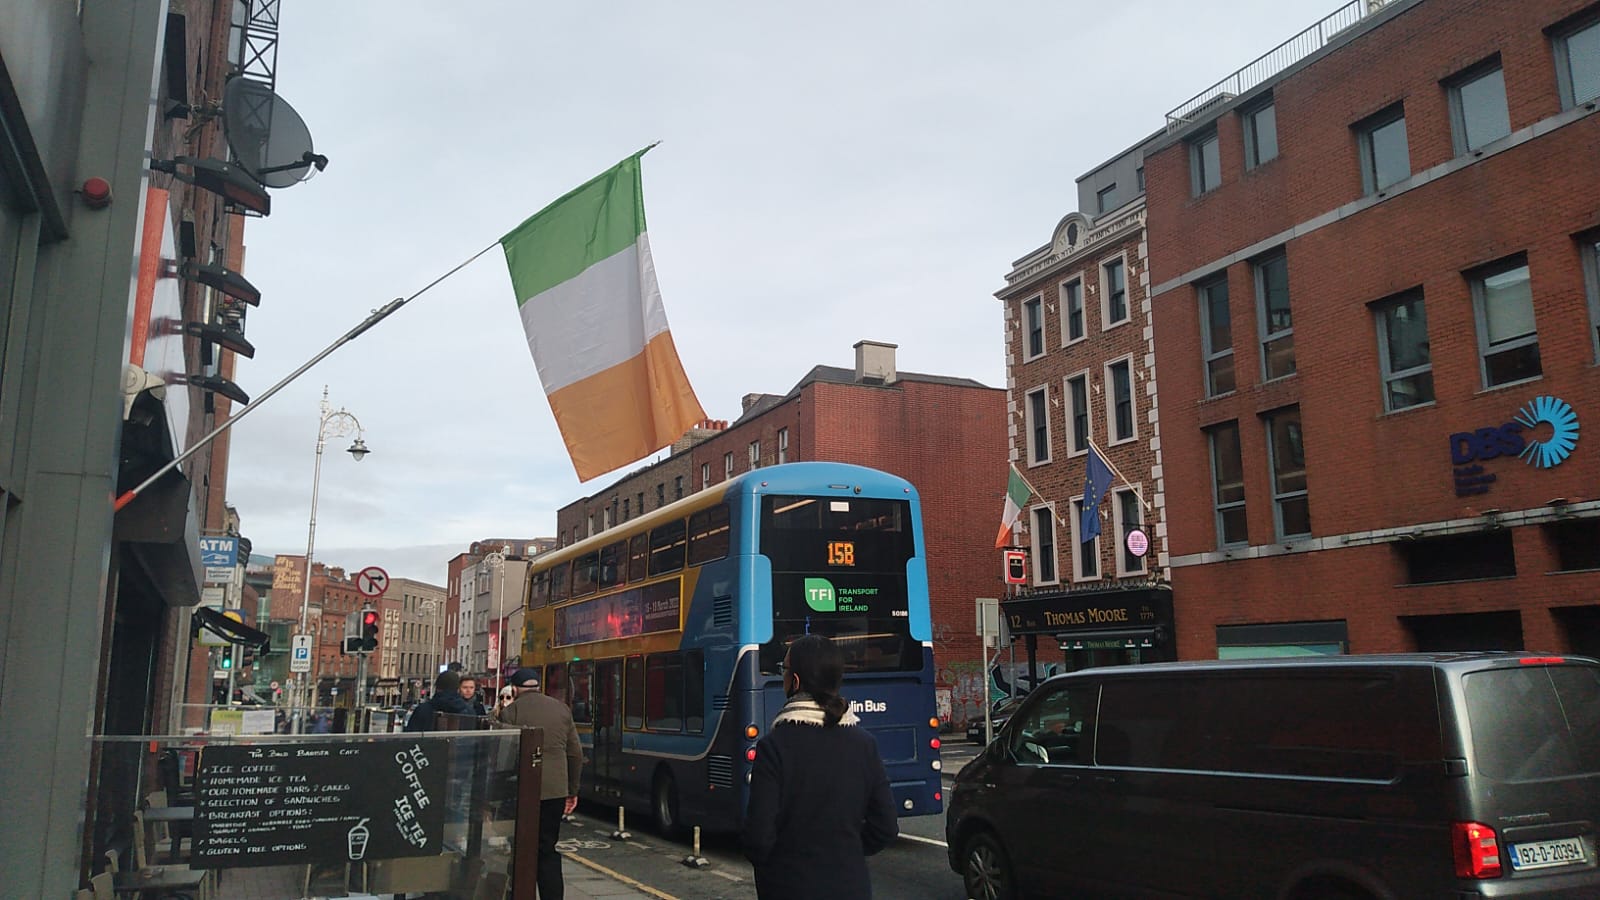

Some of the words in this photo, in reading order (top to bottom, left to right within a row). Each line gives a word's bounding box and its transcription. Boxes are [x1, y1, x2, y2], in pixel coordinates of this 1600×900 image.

[1450, 422, 1526, 465] DBS
[200, 539, 233, 552] ATM
[827, 542, 854, 565] 15B
[808, 588, 832, 601] TFI
[1010, 615, 1021, 628] 12
[1044, 611, 1086, 626] THOMAS
[1087, 608, 1129, 623] MOORE
[864, 699, 887, 713] Bus
[409, 743, 430, 770] ICE
[210, 765, 233, 774] ICE
[241, 764, 277, 774] COFFEE
[209, 775, 260, 785] HOMEMADE
[268, 775, 283, 783] ICE
[289, 775, 308, 783] TEA
[395, 751, 430, 809] COFFEE
[208, 787, 229, 796] OUR
[231, 786, 279, 796] HOMEMADE
[285, 785, 311, 794] BARS
[321, 784, 351, 792] CAKES
[208, 799, 258, 807] SELECTION
[283, 796, 341, 805] SANDWICHES
[208, 810, 262, 820] BREAKFAST
[395, 795, 415, 821] ICE
[409, 821, 427, 848] TEA
[209, 837, 248, 845] BAGELS
[207, 847, 240, 856] GLUTEN
[247, 846, 266, 854] FREE
[271, 844, 307, 852] OPTIONS
[1518, 843, 1580, 864] 192-D-20394
